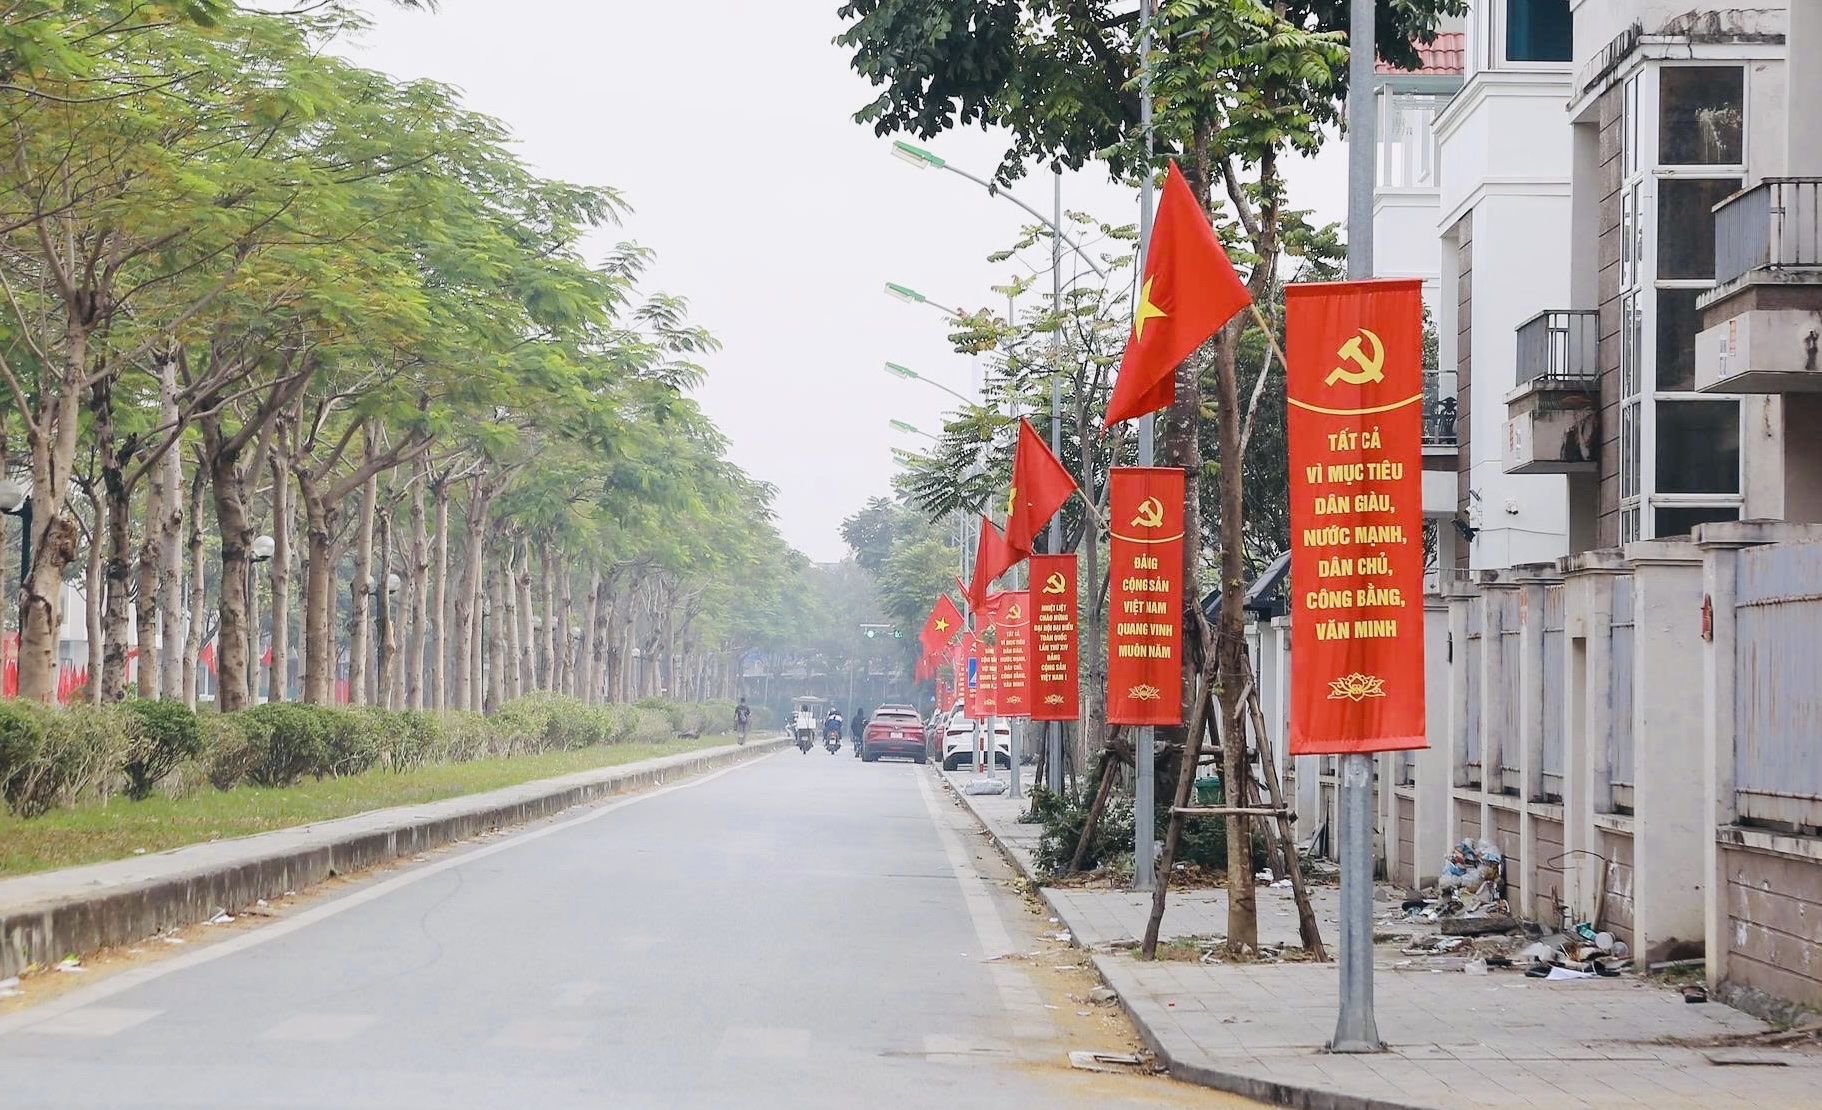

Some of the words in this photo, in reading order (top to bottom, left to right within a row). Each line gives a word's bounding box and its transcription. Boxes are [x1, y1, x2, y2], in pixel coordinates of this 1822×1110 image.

[1328, 427, 1358, 451] TẤT
[1362, 426, 1382, 449] CẢ
[1306, 463, 1323, 484] VÌ
[1328, 464, 1364, 485] MỤC
[1367, 460, 1403, 480] TIÊU
[1315, 494, 1351, 515] DÂN
[1355, 491, 1395, 513] GIÀU,
[1304, 525, 1351, 546] NƯỚC
[1355, 526, 1407, 547] MẠNH,
[1134, 553, 1158, 570] ĐẢNG
[1318, 556, 1353, 577] DÂN
[1358, 552, 1393, 576] CHỦ,
[1122, 576, 1148, 593] CỘNG
[1149, 576, 1169, 593] SẢN
[1306, 588, 1353, 609] CÔNG
[1357, 583, 1406, 607] BẰNG,
[1123, 599, 1144, 616] VIỆT
[1117, 623, 1148, 636] QUANG
[1149, 623, 1173, 637] VINH
[1316, 619, 1350, 640] VĂN
[1354, 620, 1397, 639] MINH
[1118, 643, 1147, 657] MUÔN
[1148, 643, 1171, 659] NĂM
